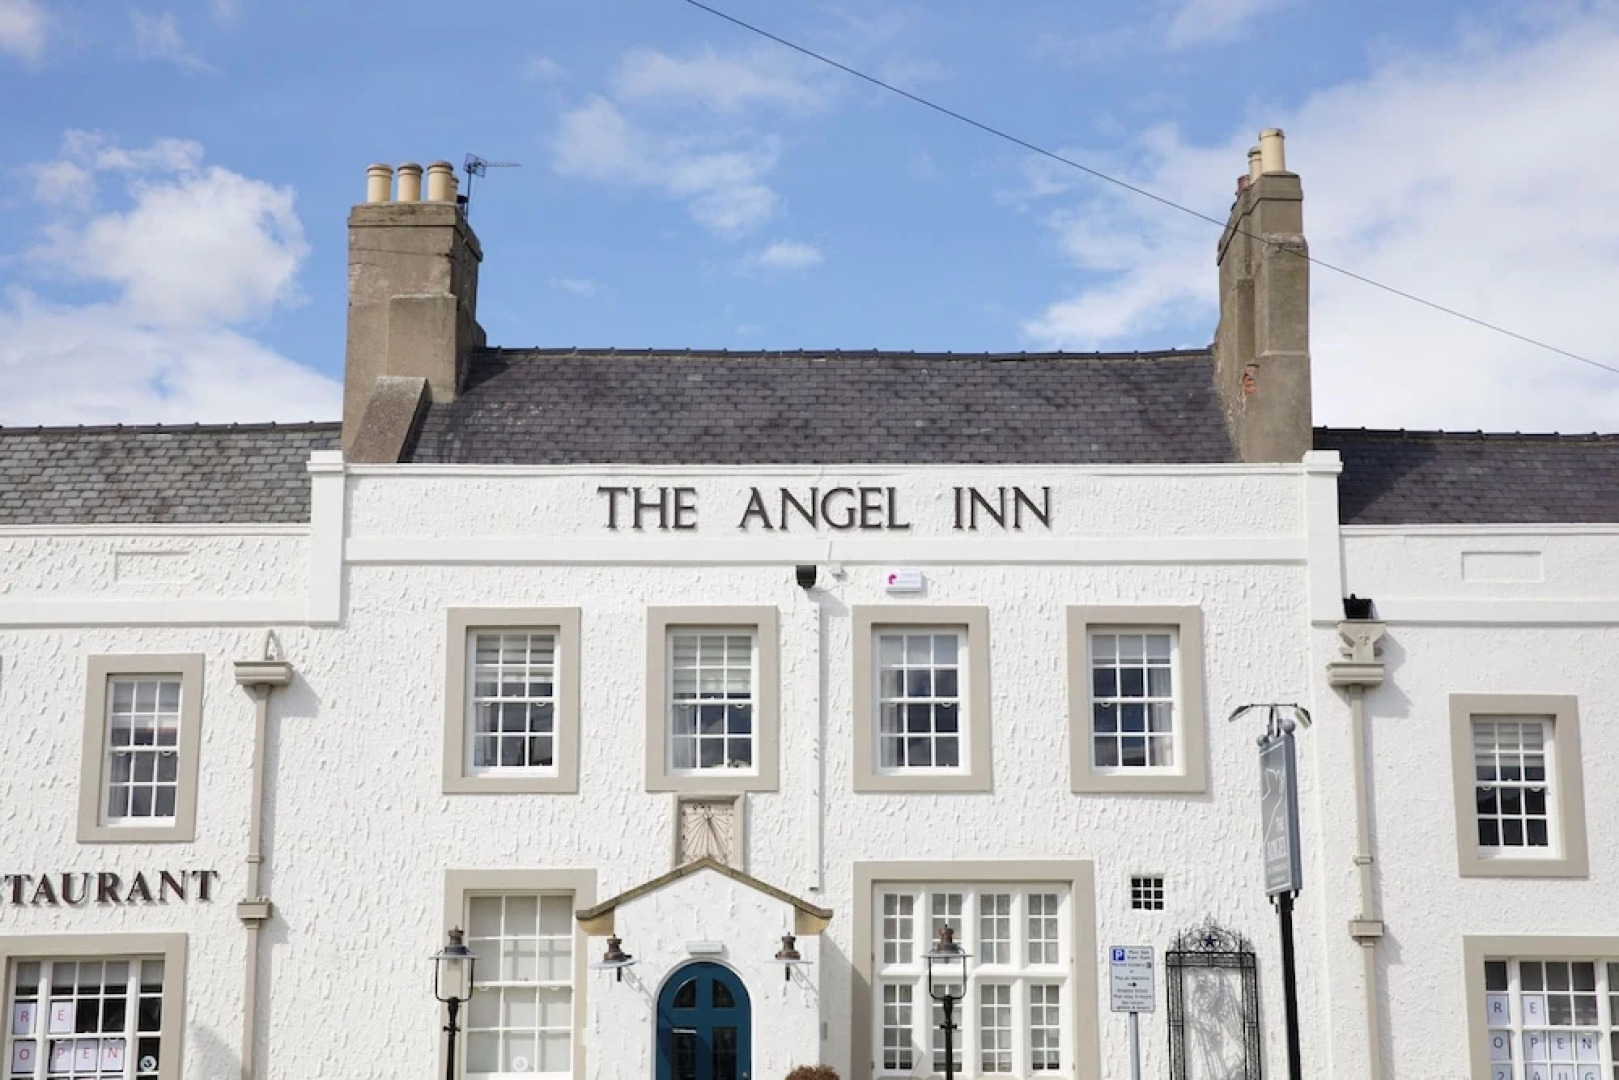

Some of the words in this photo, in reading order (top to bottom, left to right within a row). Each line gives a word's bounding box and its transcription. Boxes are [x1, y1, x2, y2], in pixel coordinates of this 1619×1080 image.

[599, 486, 697, 530] THE
[738, 487, 911, 530] ANGEL
[953, 487, 1050, 530] INN
